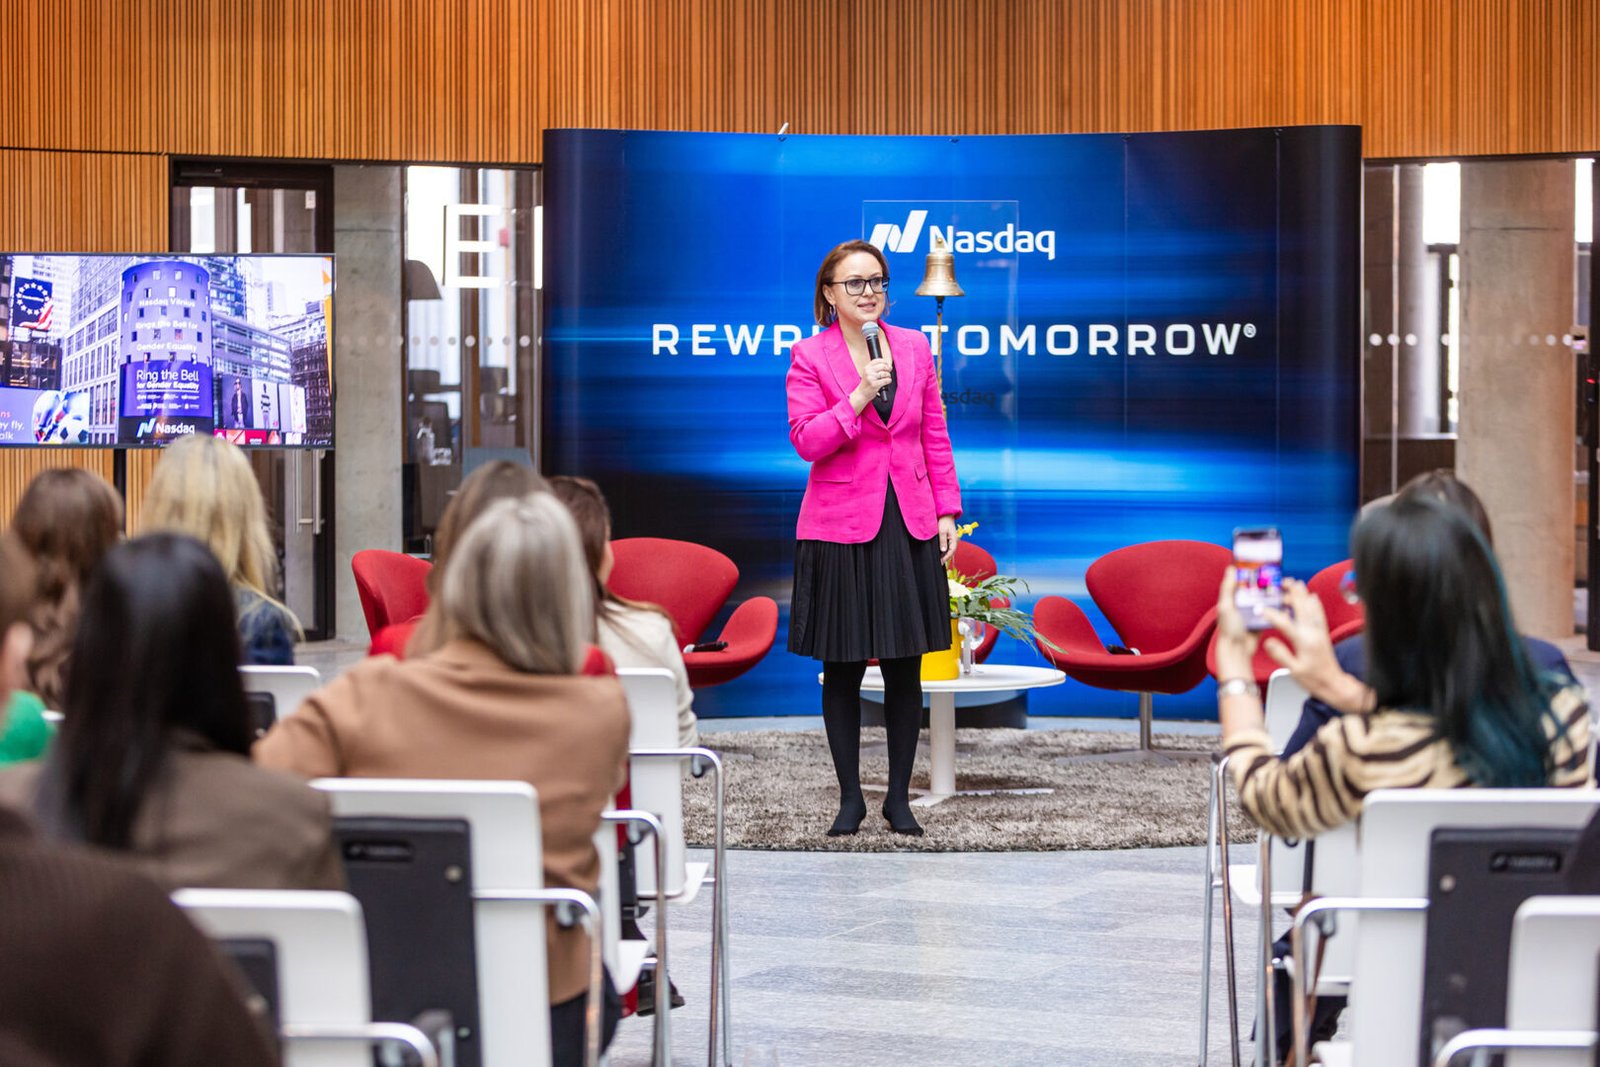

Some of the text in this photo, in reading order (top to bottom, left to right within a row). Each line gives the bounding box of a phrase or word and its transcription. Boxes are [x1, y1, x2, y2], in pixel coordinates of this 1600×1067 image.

[929, 223, 1056, 260] Nasdaq
[652, 323, 819, 356] REWR
[136, 369, 199, 382] Ring the Bell
[941, 387, 996, 408] asdaq
[0, 432, 14, 440] alk
[155, 422, 195, 435] Nasdaq
